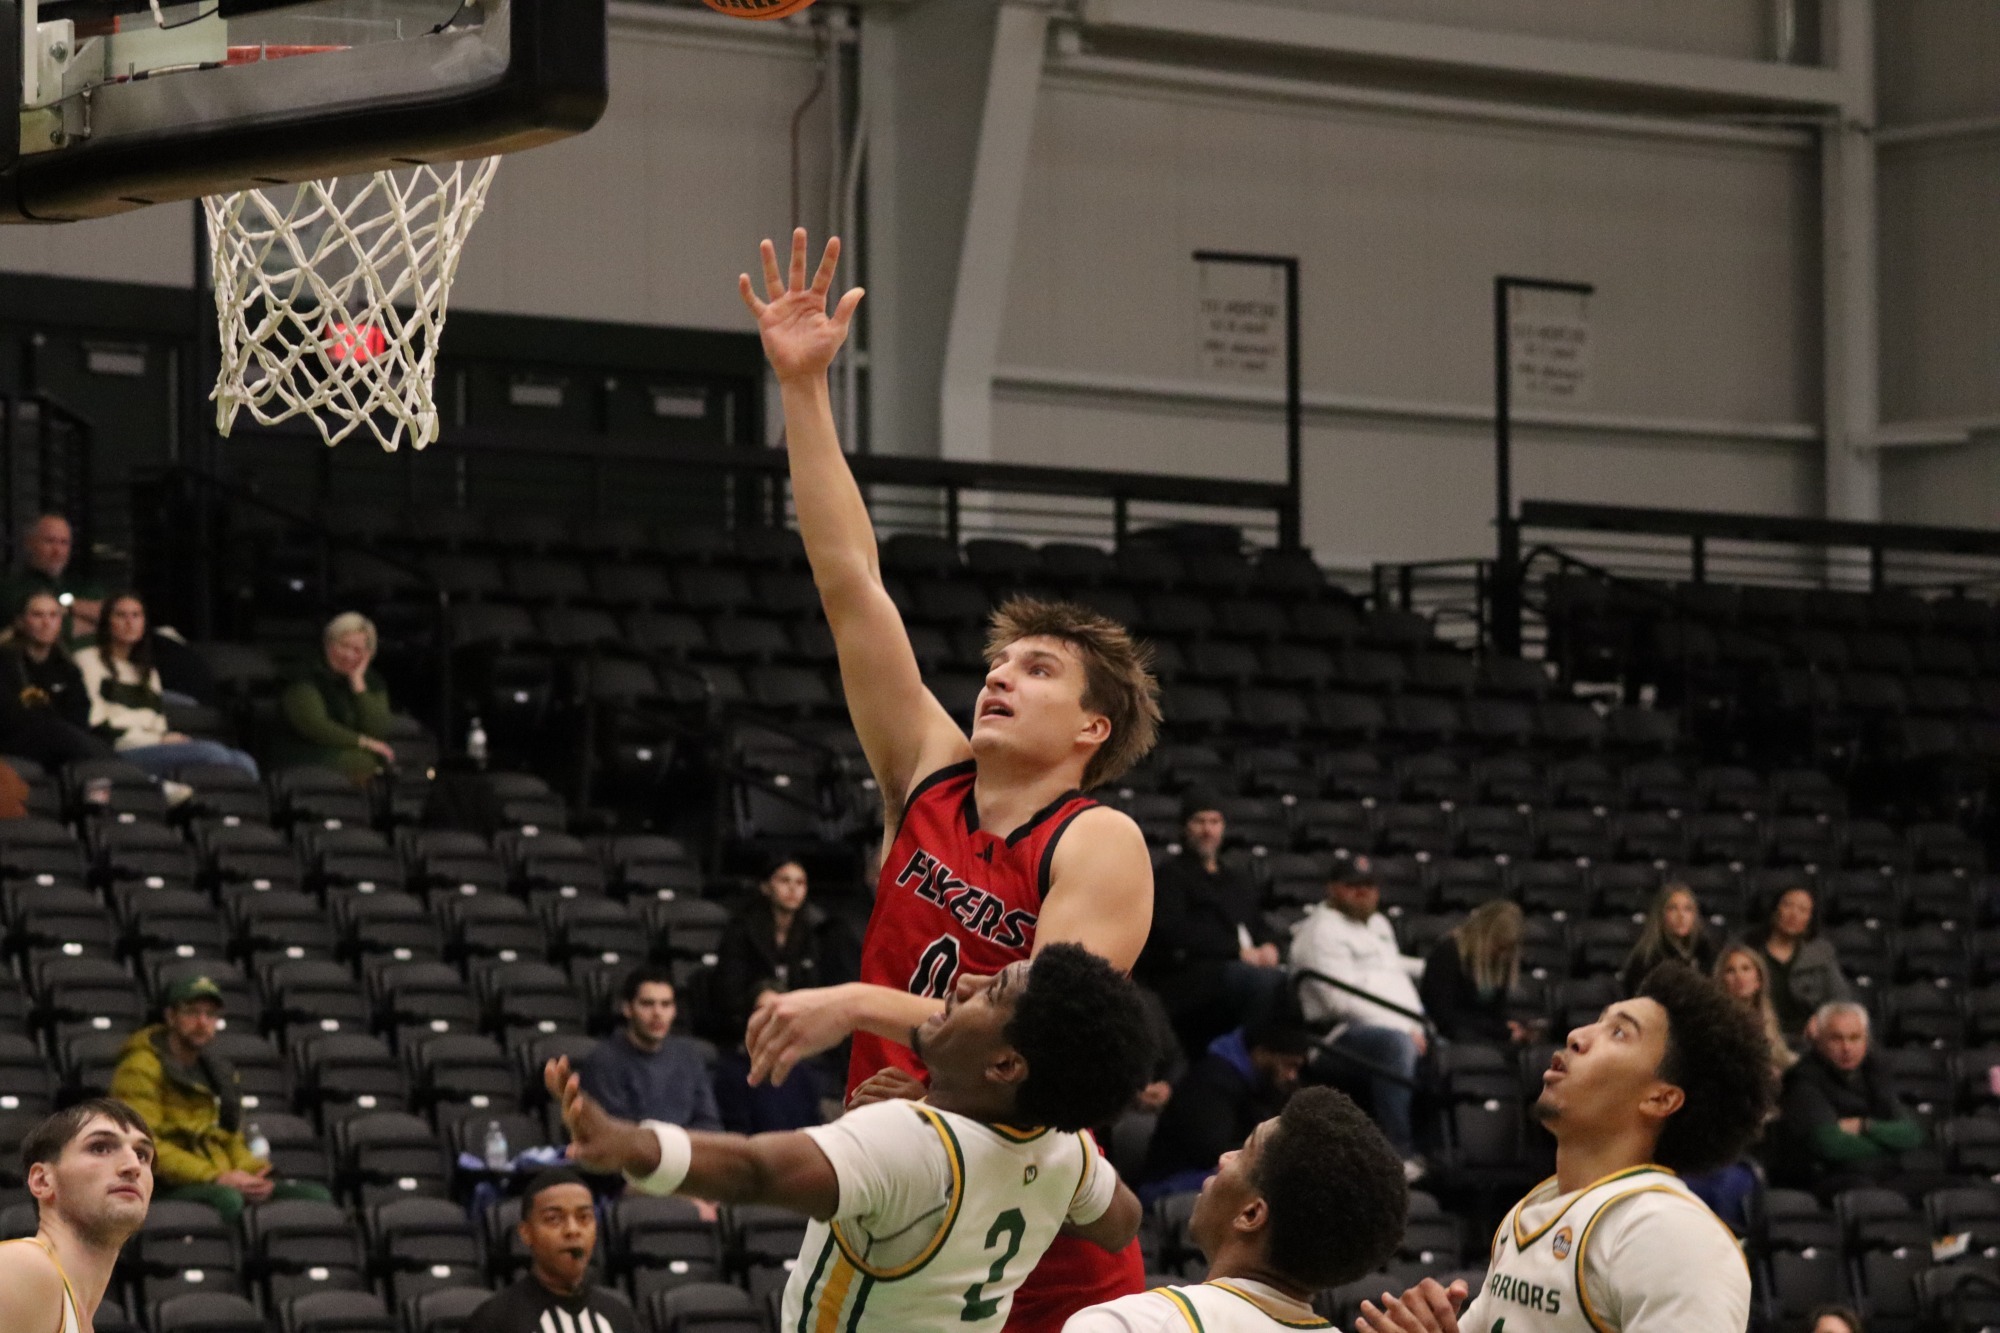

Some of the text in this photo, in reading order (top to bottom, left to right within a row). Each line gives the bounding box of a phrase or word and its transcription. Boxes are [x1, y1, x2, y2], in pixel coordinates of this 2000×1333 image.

[896, 848, 1037, 948] FLYERS
[908, 933, 960, 999] 0
[961, 1207, 1027, 1322] 2
[1490, 1273, 1561, 1315] RRIORS
